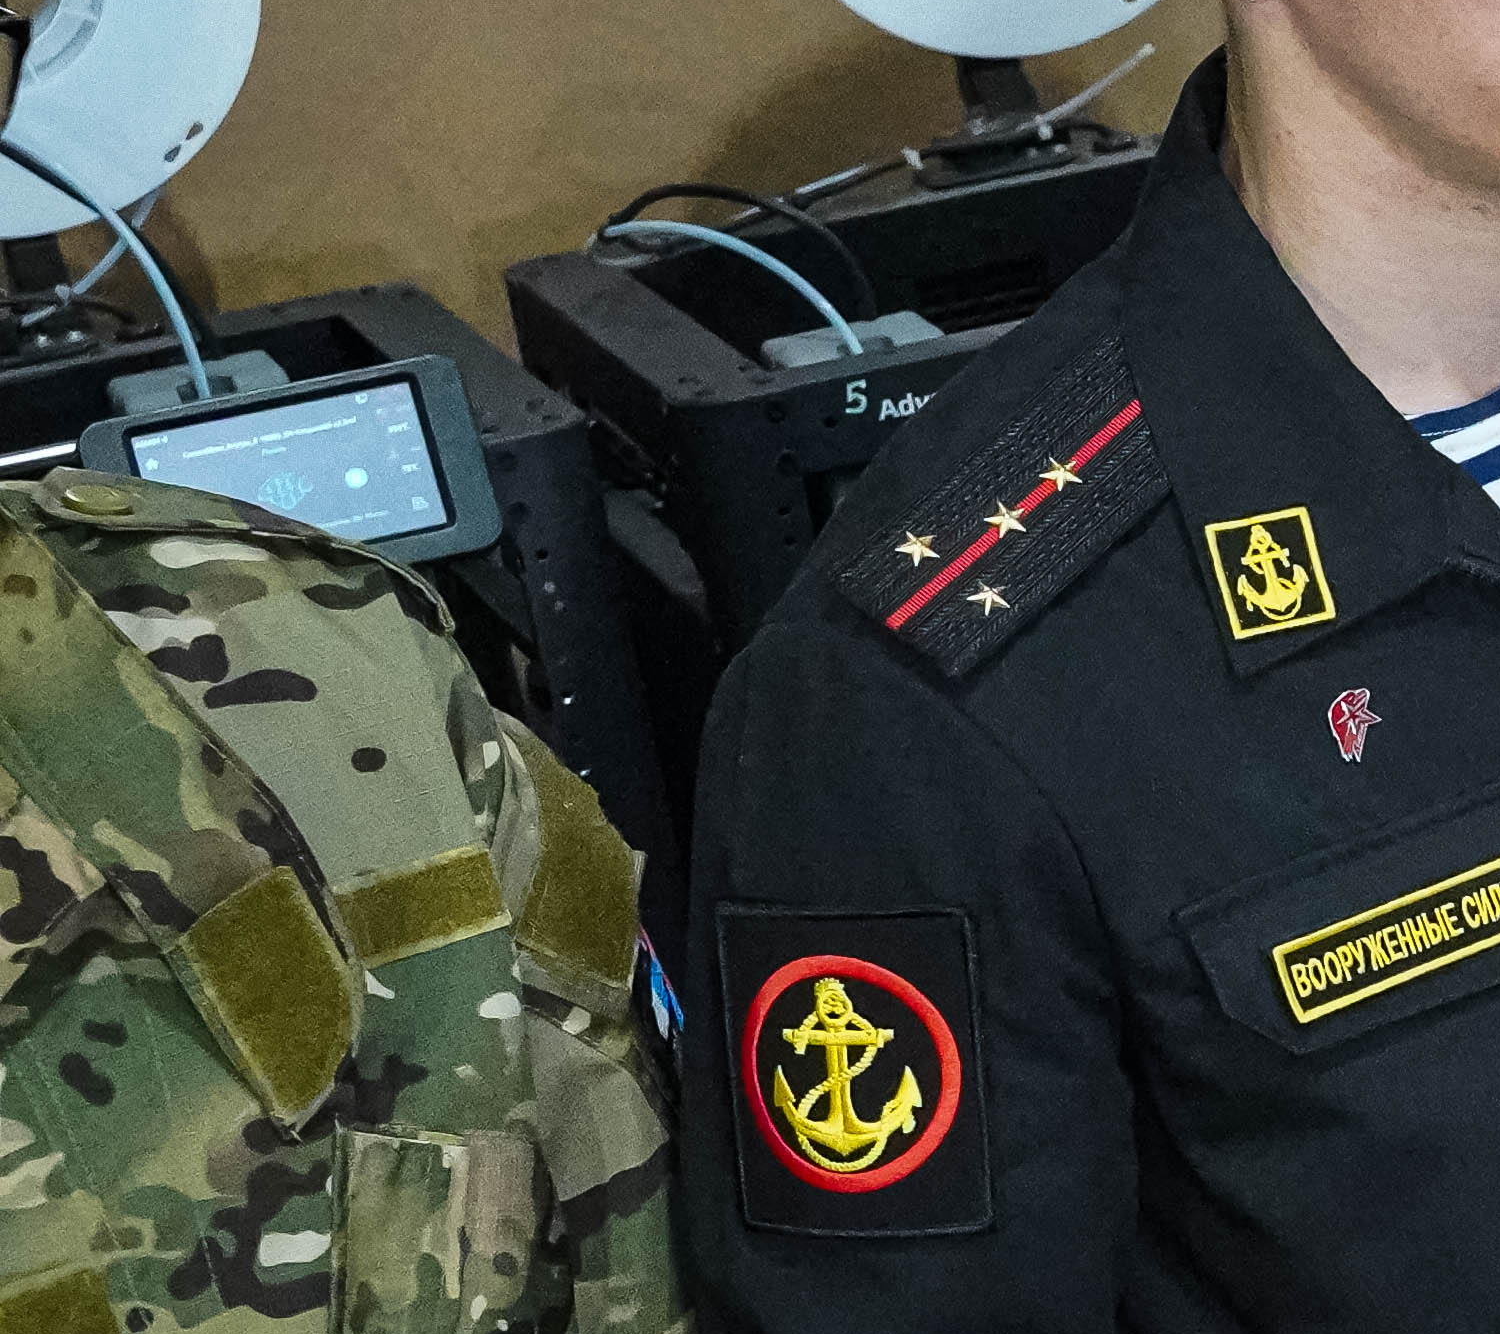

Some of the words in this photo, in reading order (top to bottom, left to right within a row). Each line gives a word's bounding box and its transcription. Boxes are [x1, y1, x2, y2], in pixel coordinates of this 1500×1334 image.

[844, 378, 868, 414] 5
[878, 391, 938, 422] Adv
[1290, 902, 1465, 998] ВООРУЖЕННЫЕ
